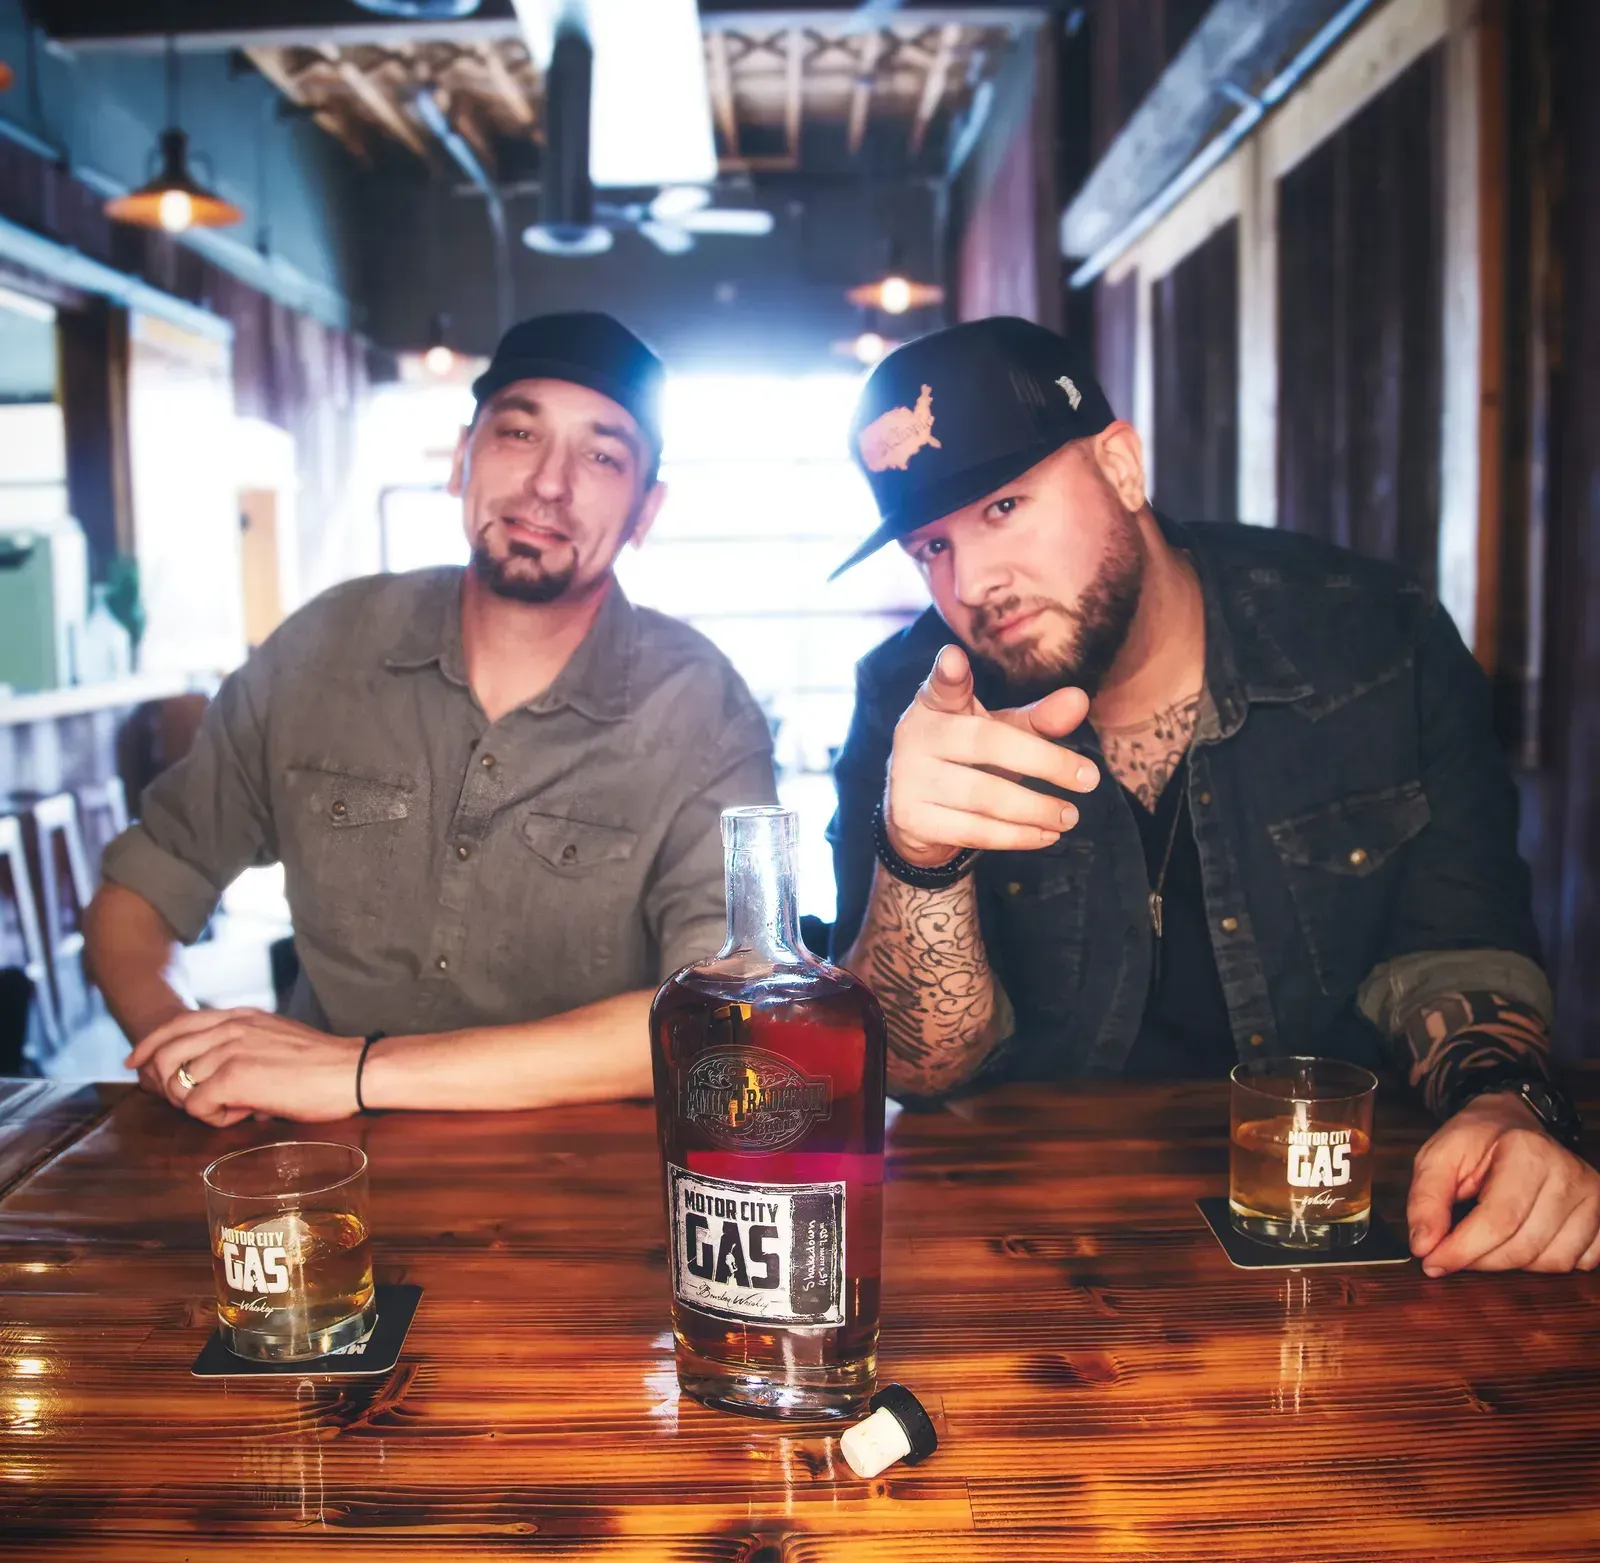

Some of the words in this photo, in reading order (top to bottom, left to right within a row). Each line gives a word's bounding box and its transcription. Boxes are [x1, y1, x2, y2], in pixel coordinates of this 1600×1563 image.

[1288, 1131, 1329, 1146] MOTOR
[1329, 1130, 1351, 1145] CITY
[1287, 1144, 1351, 1187] GAS
[684, 1189, 737, 1220] MOTOR
[740, 1201, 778, 1223] CITY
[221, 1226, 257, 1247] MOTOR
[257, 1231, 284, 1247] CITY
[686, 1212, 780, 1290] GAS
[802, 1220, 816, 1292] Shakedown
[222, 1242, 289, 1293] GAS
